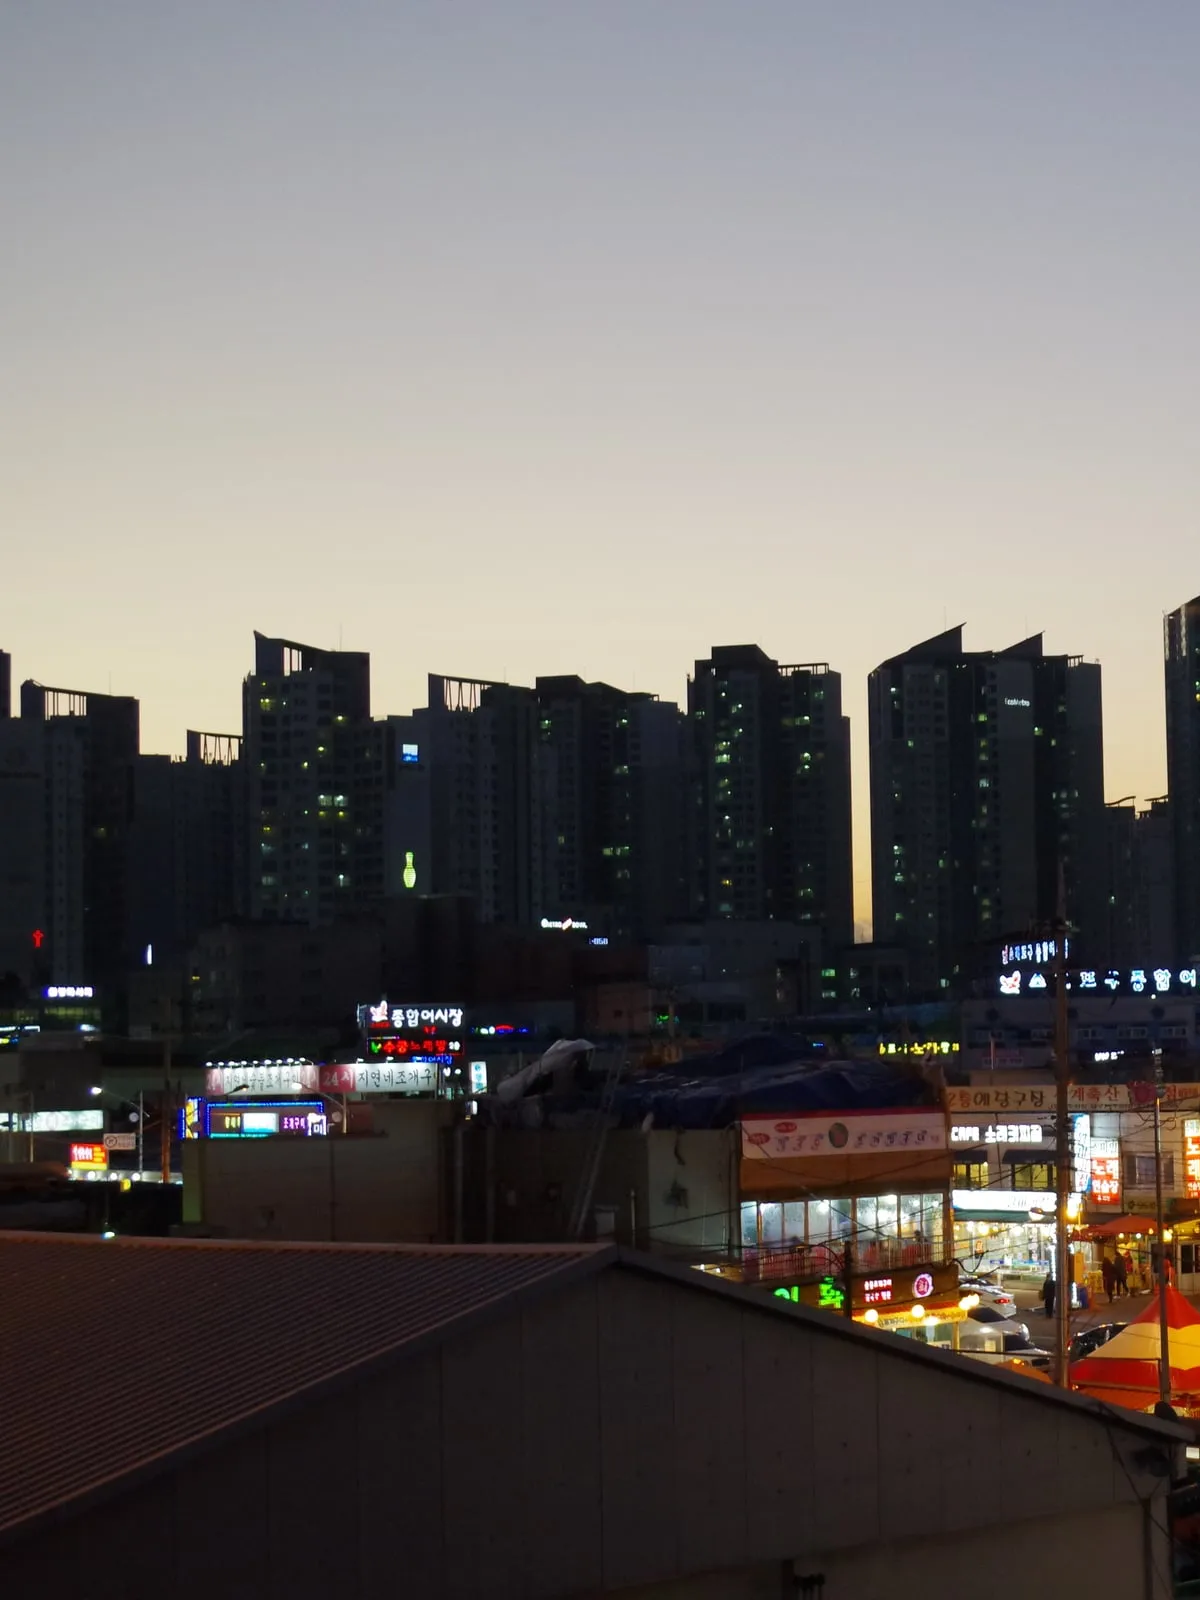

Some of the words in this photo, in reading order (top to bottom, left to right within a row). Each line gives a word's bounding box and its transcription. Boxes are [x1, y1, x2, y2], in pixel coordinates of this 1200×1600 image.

[391, 1008, 463, 1028] 종합어시장
[358, 1067, 437, 1089] 지연네조개구
[1092, 1159, 1119, 1180] 노래
